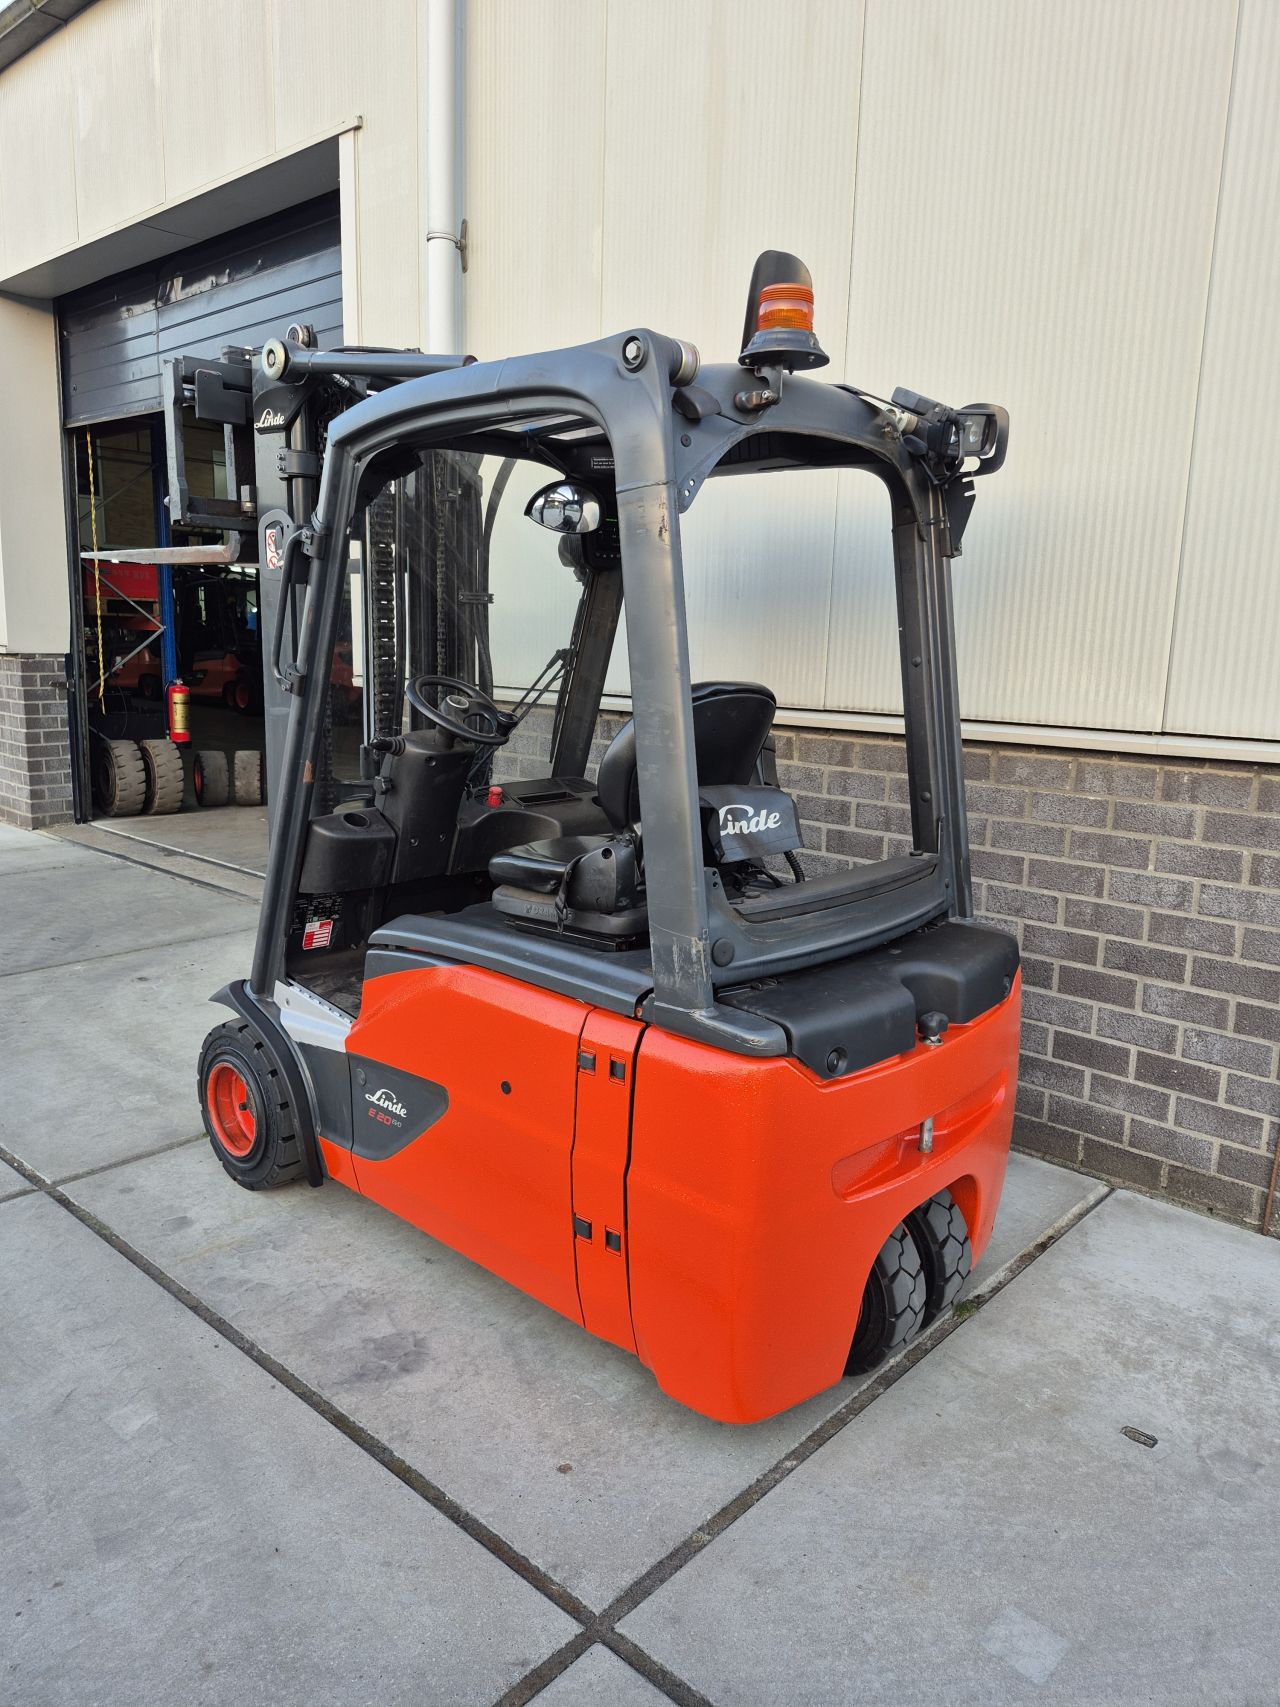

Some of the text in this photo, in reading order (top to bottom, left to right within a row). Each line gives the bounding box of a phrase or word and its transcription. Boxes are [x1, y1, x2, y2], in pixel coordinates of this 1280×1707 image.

[254, 408, 285, 428] Linde
[365, 1089, 407, 1118] Linde
[368, 1107, 376, 1118] E
[376, 1112, 392, 1126] 20
